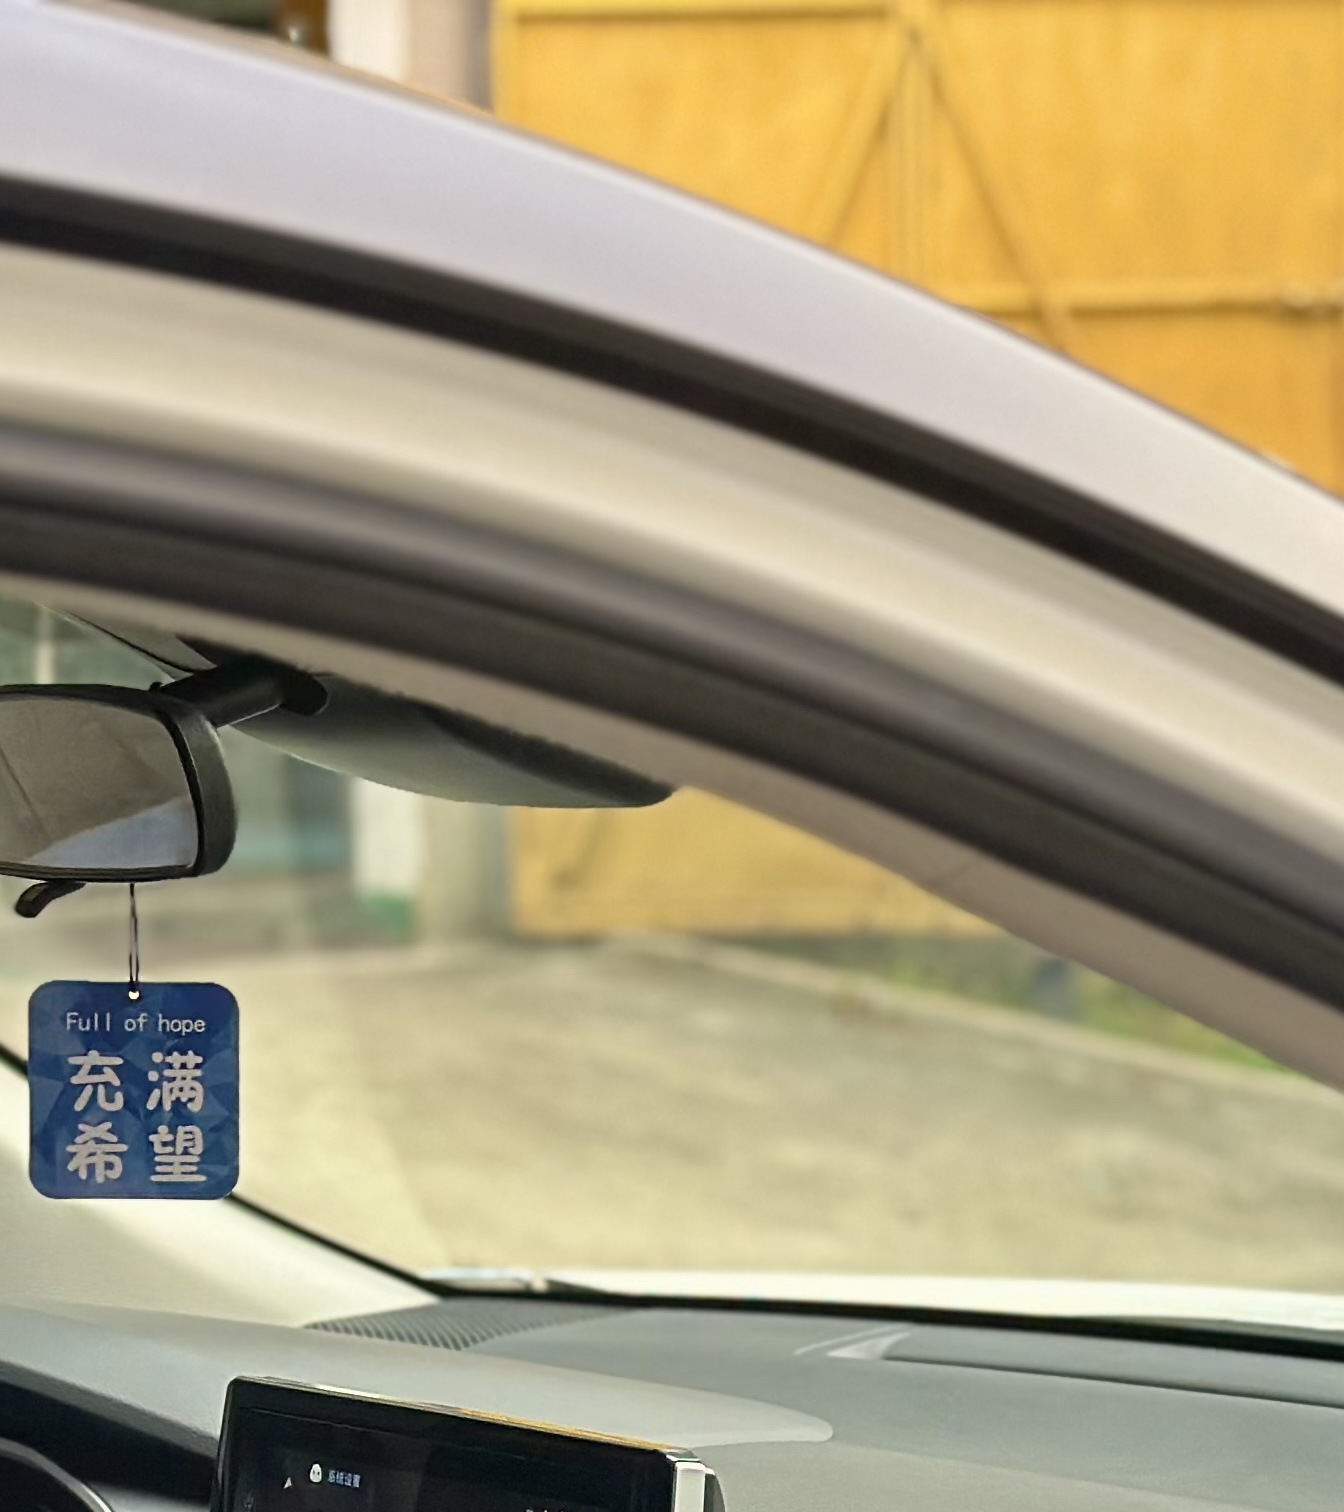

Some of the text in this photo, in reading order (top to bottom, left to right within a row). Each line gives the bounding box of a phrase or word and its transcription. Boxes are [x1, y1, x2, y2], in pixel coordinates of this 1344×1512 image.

[66, 1011, 206, 1036] Full of hope
[67, 1050, 204, 1113] 充满
[65, 1121, 207, 1184] 希望
